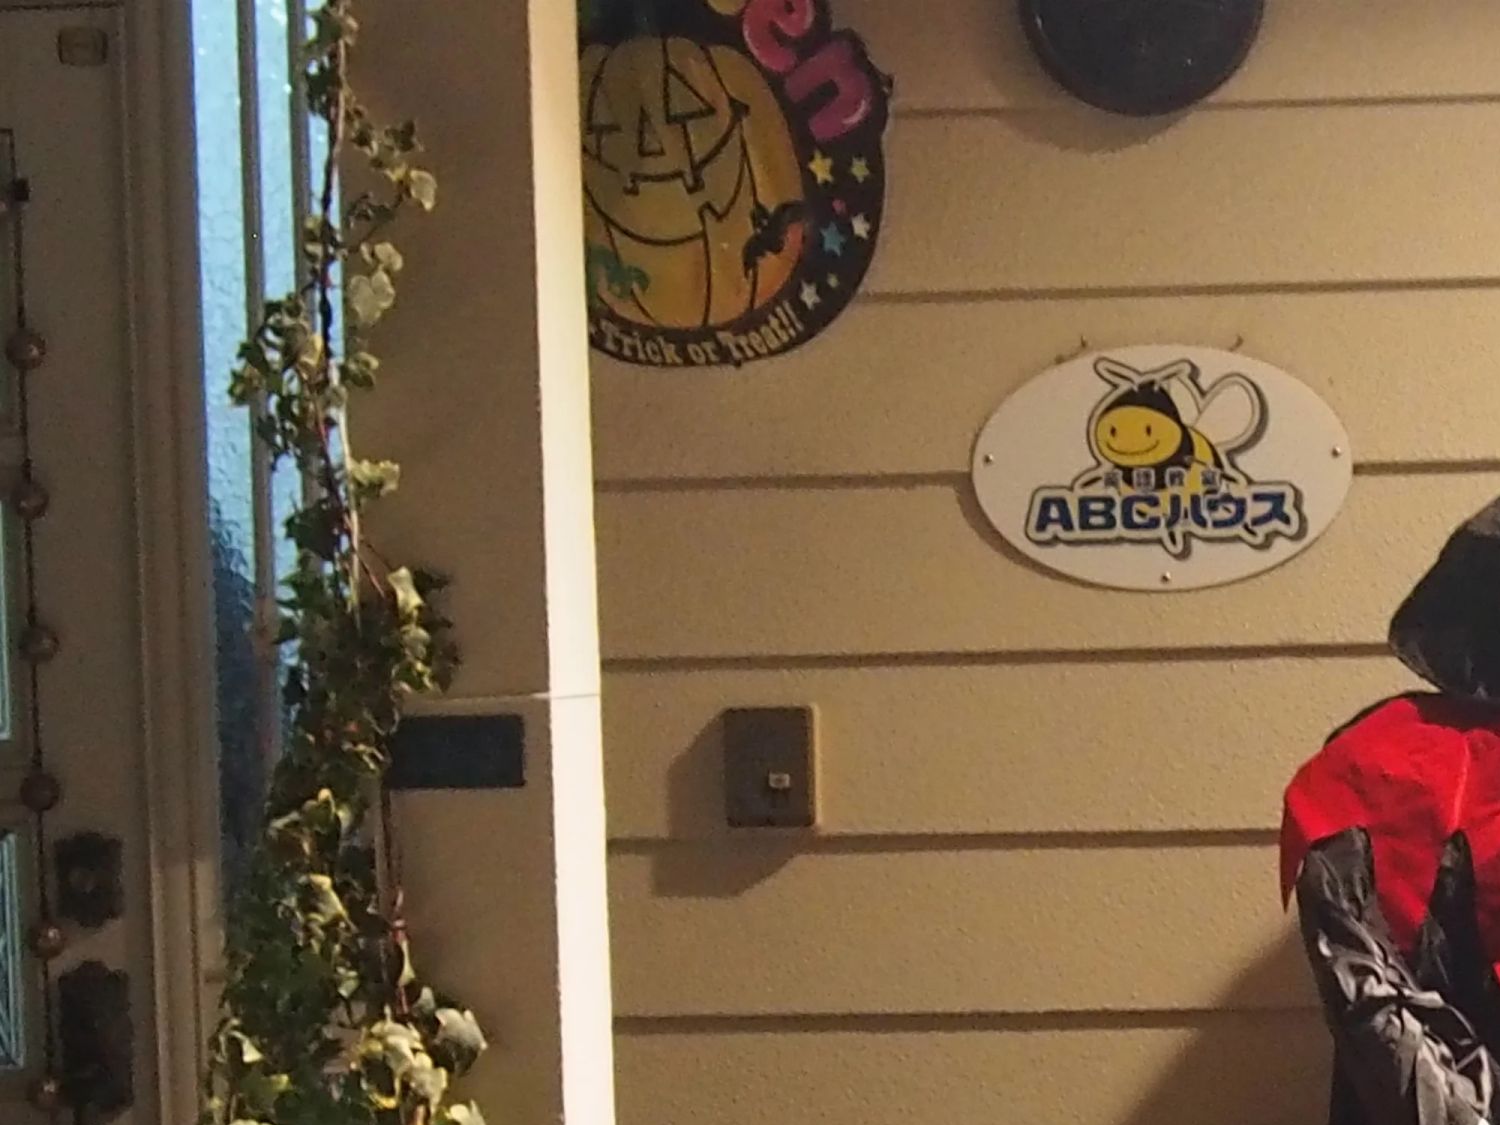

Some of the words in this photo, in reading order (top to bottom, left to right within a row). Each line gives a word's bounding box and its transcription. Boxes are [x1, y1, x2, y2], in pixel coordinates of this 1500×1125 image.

[599, 318, 684, 365] Trick
[687, 341, 720, 365] or
[1034, 492, 1291, 533] ABCハウス
